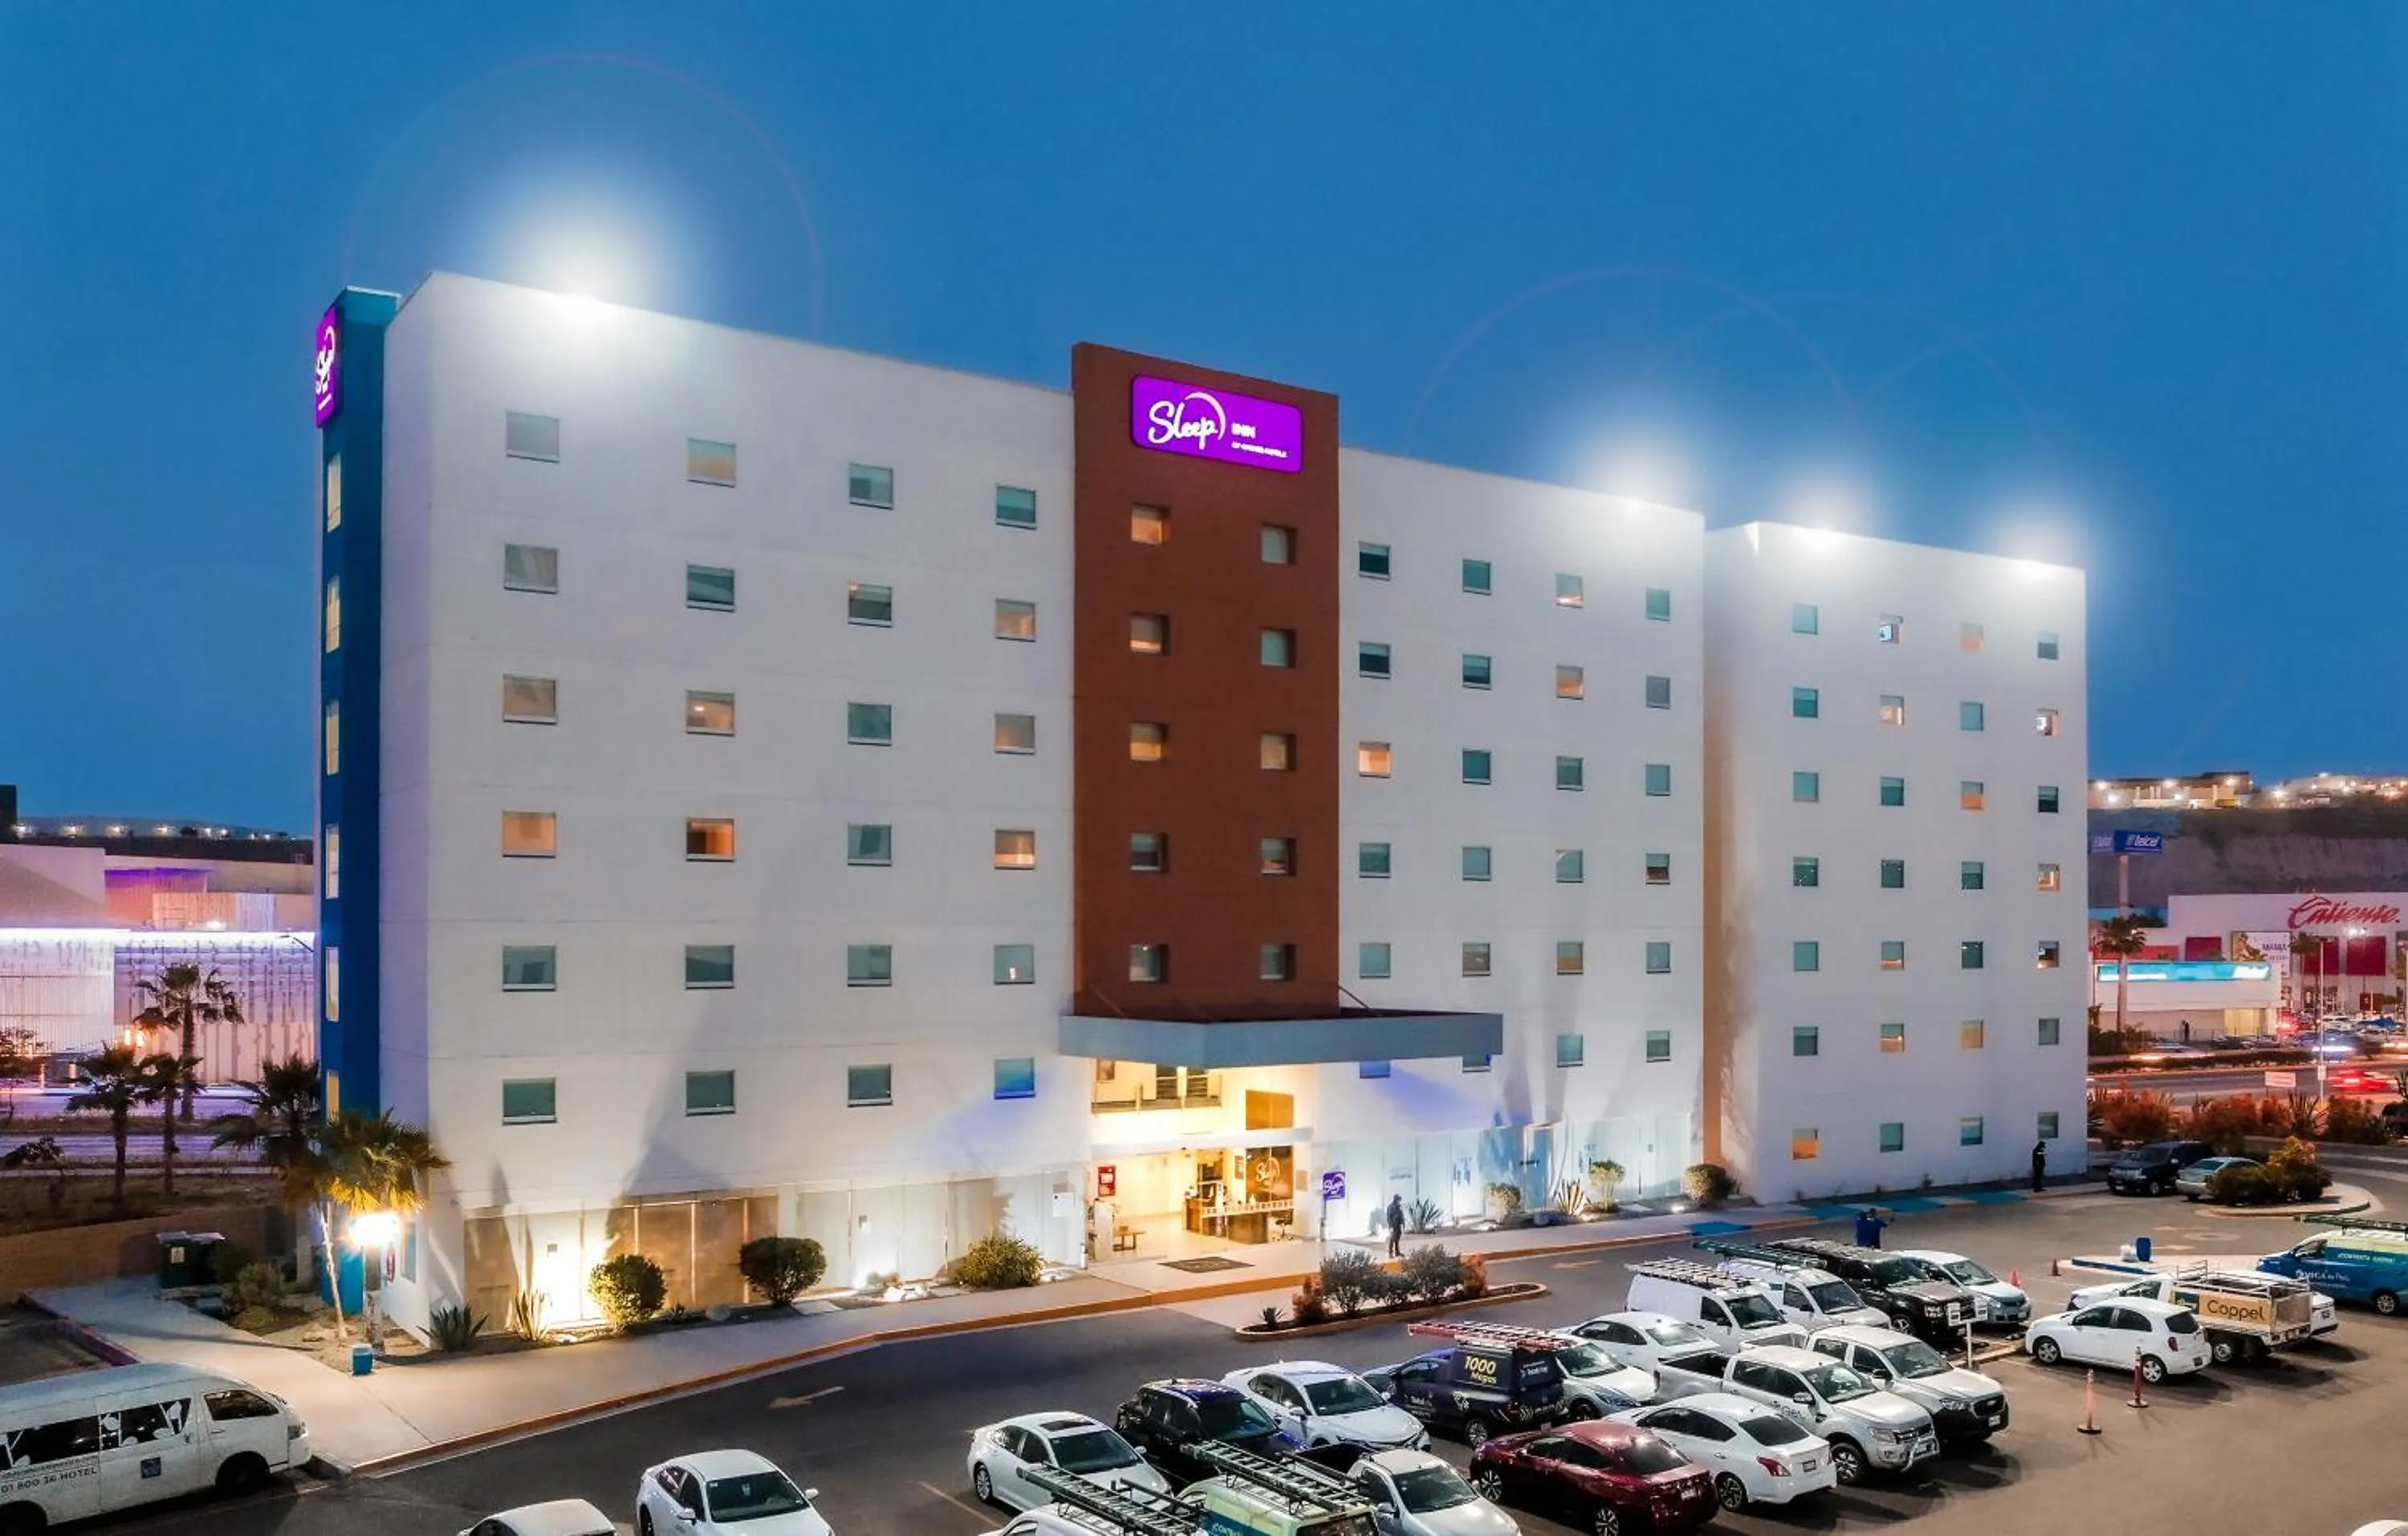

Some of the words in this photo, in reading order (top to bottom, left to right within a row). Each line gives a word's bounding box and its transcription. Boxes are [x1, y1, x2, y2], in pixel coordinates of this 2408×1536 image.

[1148, 400, 1218, 449] Sleep
[2288, 896, 2400, 929] Caliente
[2207, 1299, 2264, 1321] Coppel
[1464, 1355, 1496, 1375] 1000
[1470, 1371, 1497, 1384] Megas
[17, 1479, 39, 1490] 800
[60, 1466, 97, 1481] HOTEL
